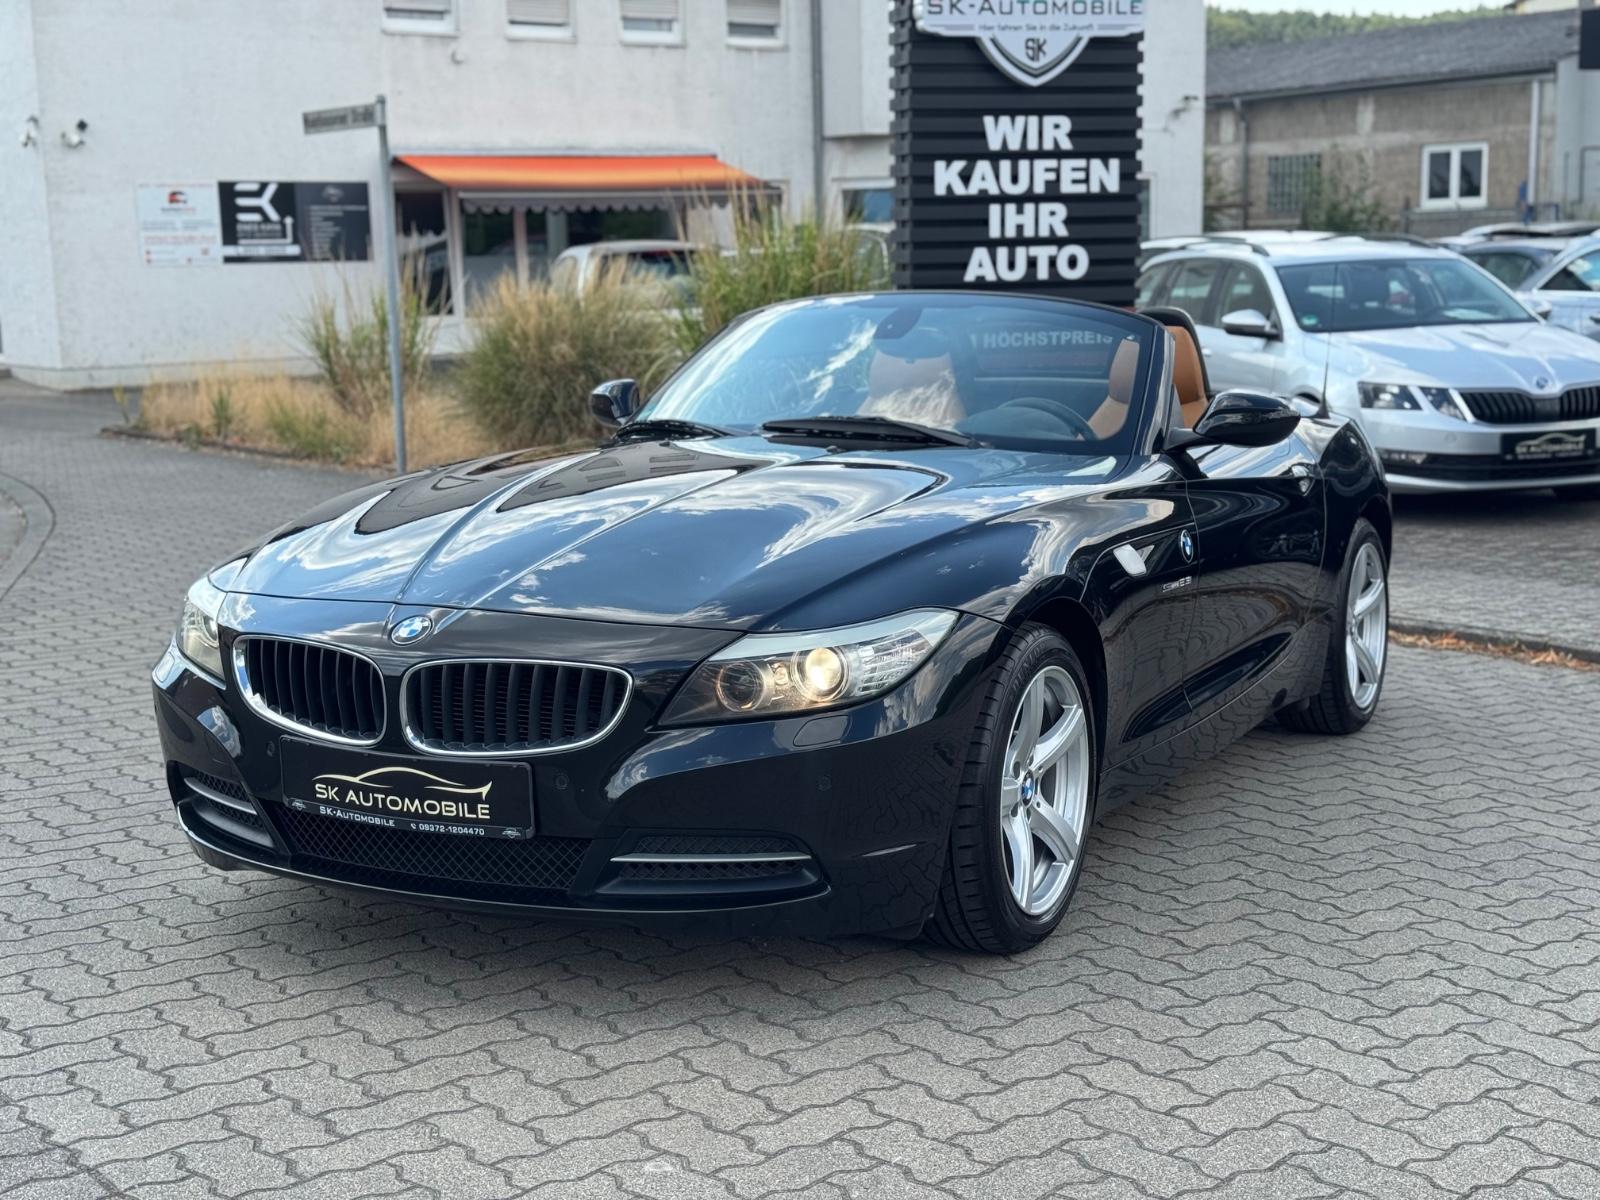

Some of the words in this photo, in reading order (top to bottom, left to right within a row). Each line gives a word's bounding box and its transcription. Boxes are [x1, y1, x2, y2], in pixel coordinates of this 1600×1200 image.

[983, 115, 1073, 150] WIR
[934, 158, 1120, 196] KAUFEN
[988, 202, 1069, 238] IHR
[963, 245, 1089, 282] AUTO
[314, 783, 340, 802] SK
[345, 789, 490, 819] AUTOMOBILE
[419, 822, 485, 836] 09372-1204470
